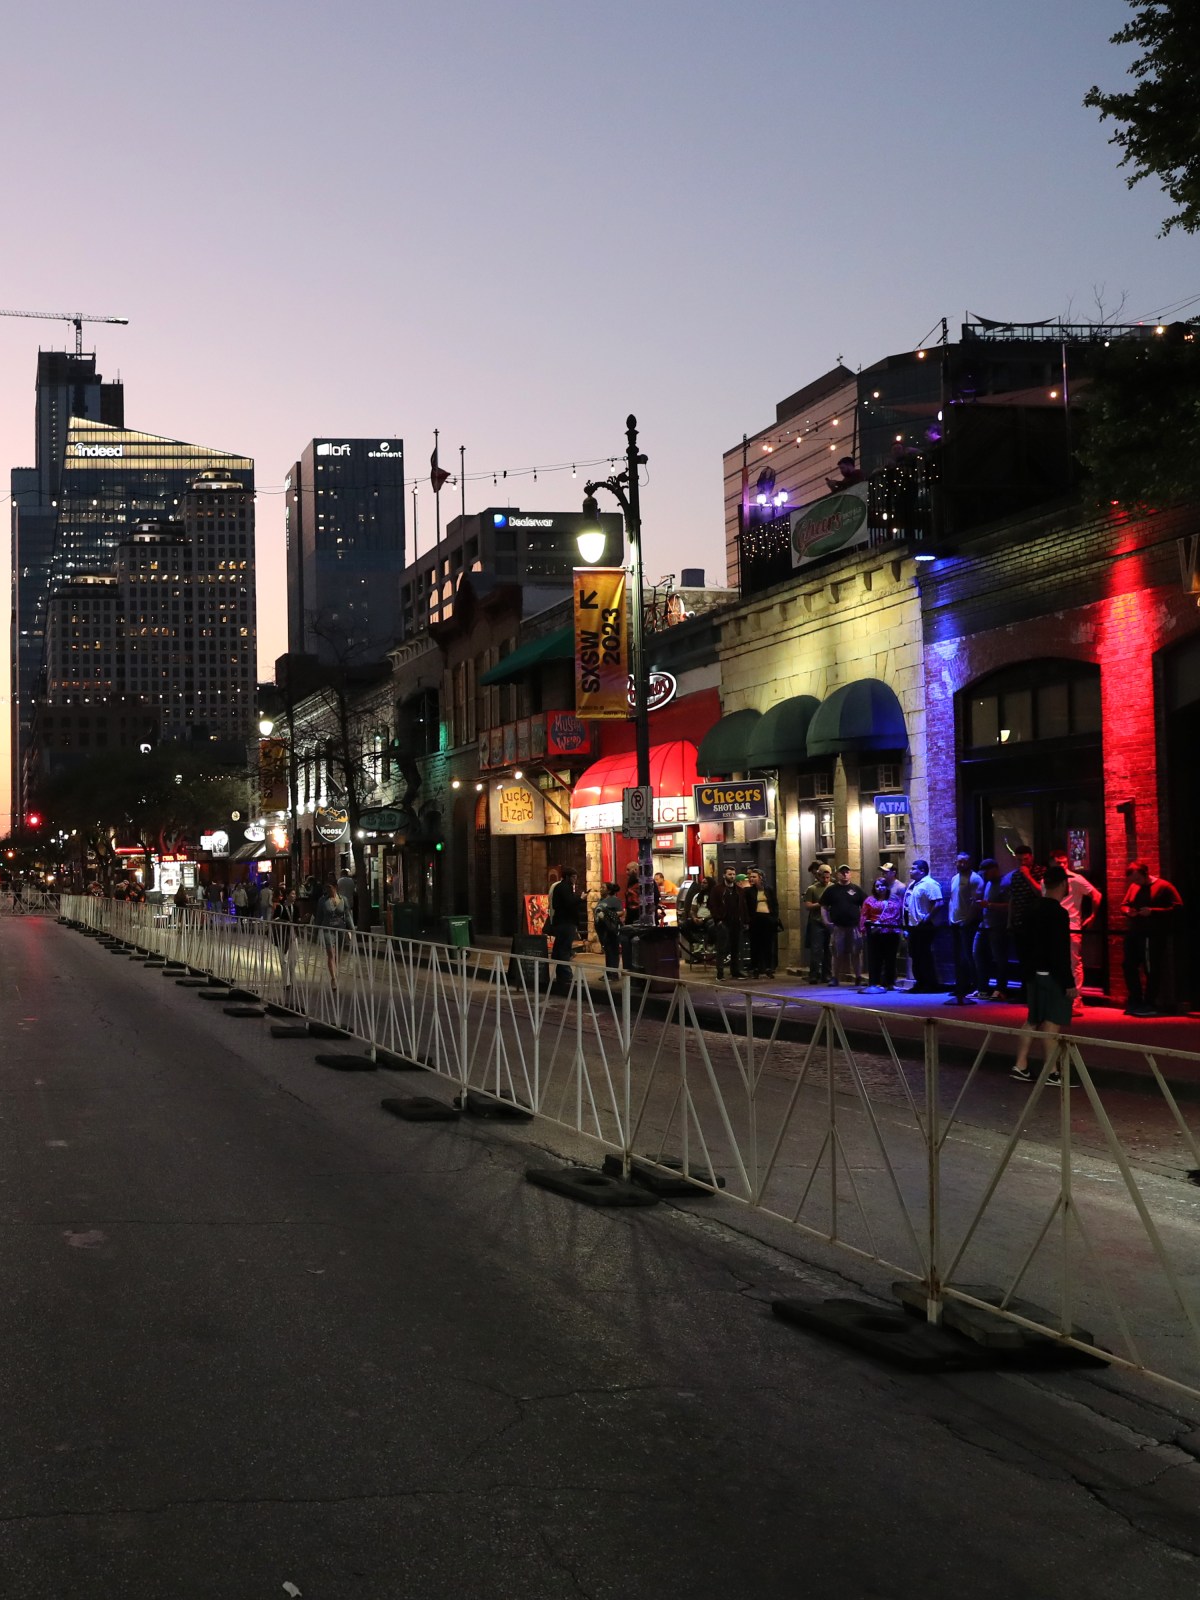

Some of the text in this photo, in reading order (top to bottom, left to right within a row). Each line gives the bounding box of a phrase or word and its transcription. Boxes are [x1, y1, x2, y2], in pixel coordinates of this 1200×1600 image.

[75, 443, 123, 457] indeed
[368, 451, 402, 459] element
[797, 512, 842, 549] Cheers
[601, 608, 621, 666] 2023
[581, 631, 600, 693] SXSW
[501, 788, 532, 804] Lucky
[701, 788, 761, 805] Cheers
[713, 802, 751, 812] SHOT BAR
[878, 800, 906, 813] ATM
[653, 807, 688, 822] ICE
